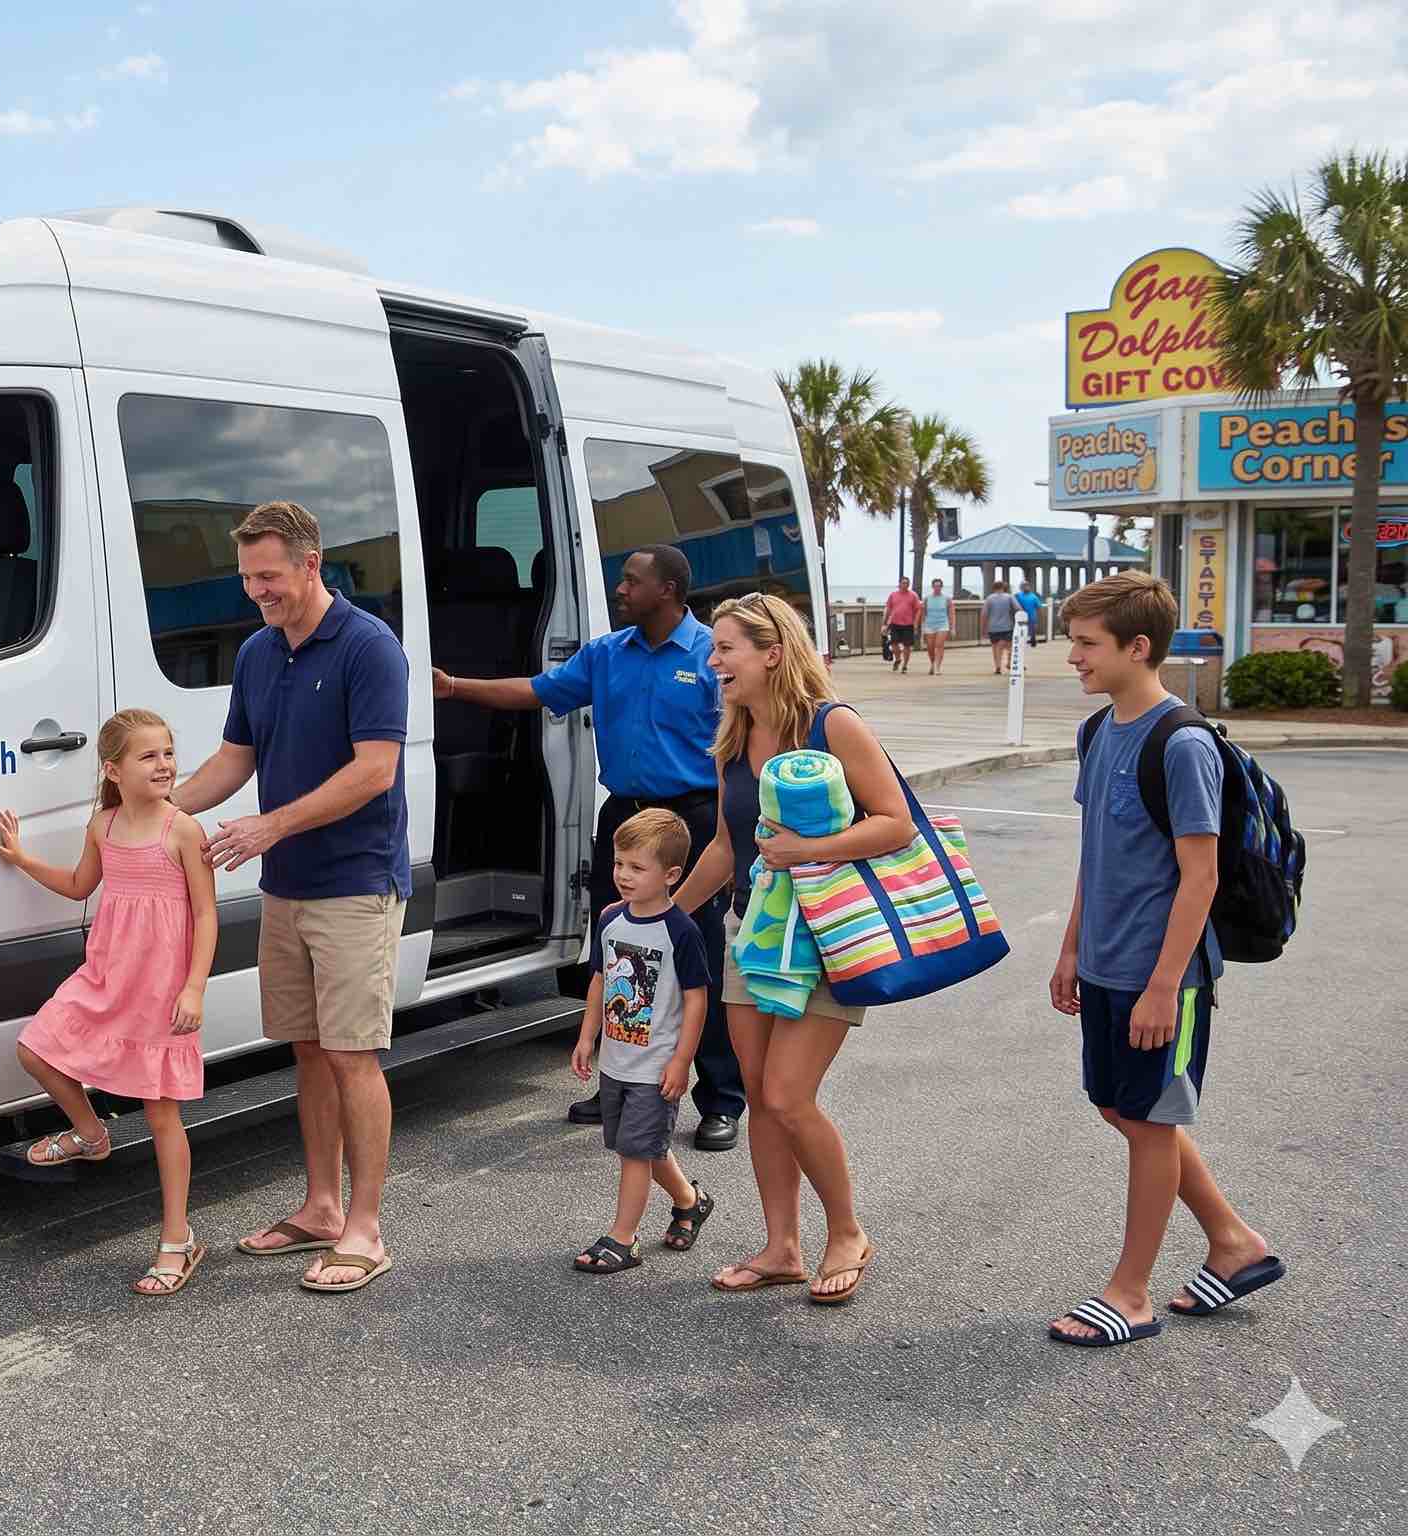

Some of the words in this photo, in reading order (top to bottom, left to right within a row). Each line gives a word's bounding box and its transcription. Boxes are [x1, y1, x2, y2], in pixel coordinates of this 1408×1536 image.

[1124, 263, 1209, 320] Gay
[1081, 368, 1152, 397] GIFT
[1161, 364, 1230, 392] COV
[1055, 421, 1147, 466] Peaches
[1218, 408, 1408, 451] Peachs
[1064, 463, 1137, 497] Corner
